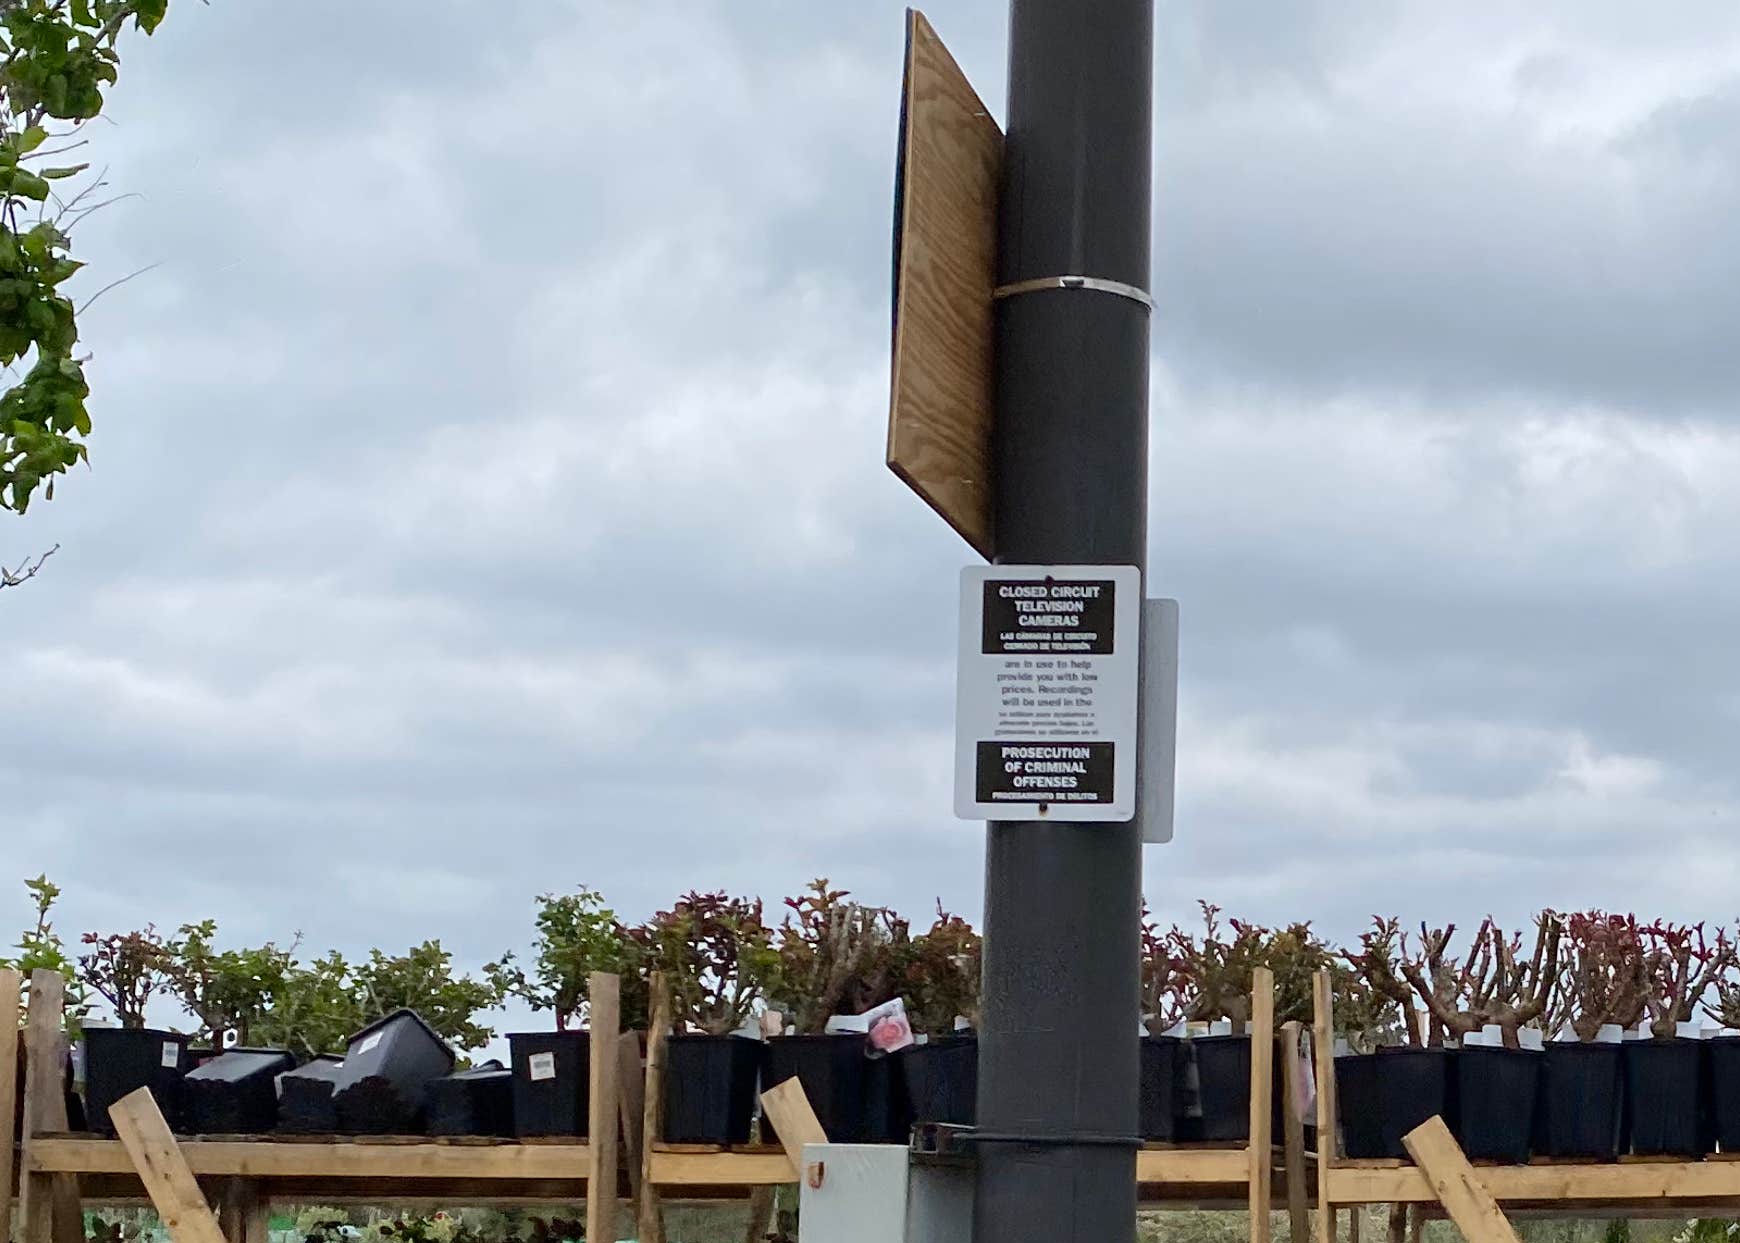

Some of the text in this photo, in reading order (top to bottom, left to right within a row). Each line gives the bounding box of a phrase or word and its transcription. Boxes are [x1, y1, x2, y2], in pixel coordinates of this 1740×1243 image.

[999, 586, 1100, 598] CLOSED CIRCUIT
[1014, 600, 1084, 612] TELEVISION
[1018, 615, 1079, 627] CAMERAS
[1005, 661, 1020, 669] are
[1036, 661, 1053, 669] use
[1057, 660, 1067, 668] to
[1070, 660, 1092, 670] help
[997, 673, 1033, 682] provide
[1036, 674, 1053, 682] you
[1057, 672, 1078, 681] with
[1038, 685, 1093, 695] Recordings
[1002, 698, 1019, 706] will
[1037, 698, 1061, 707] used
[1001, 747, 1090, 759] PROSECUTION
[1004, 761, 1087, 774] OF CRIMINAL
[1012, 776, 1078, 788] OFFENSES
